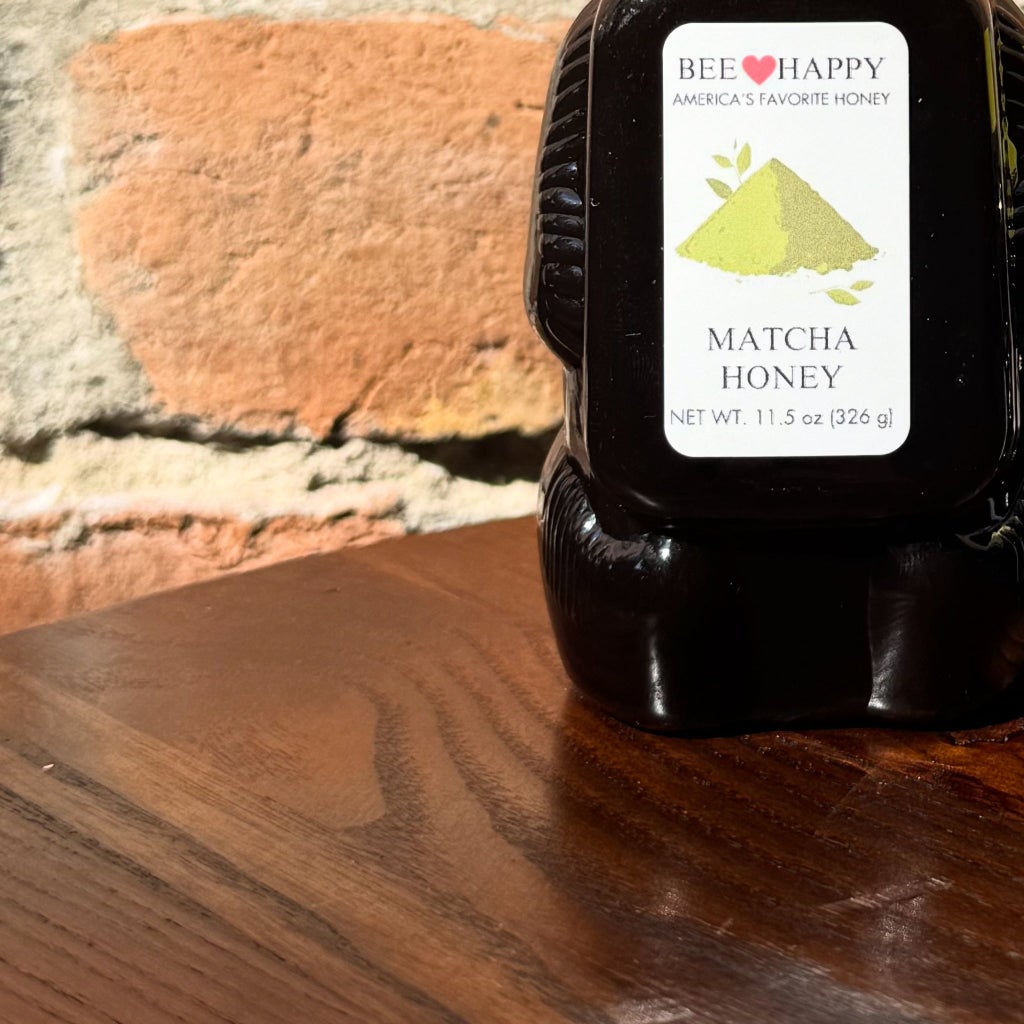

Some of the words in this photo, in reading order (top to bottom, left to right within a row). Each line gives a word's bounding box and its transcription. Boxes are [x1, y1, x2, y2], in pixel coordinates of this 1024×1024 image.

[679, 57, 738, 80] BEE
[778, 57, 886, 80] HAPPY
[672, 92, 754, 106] AMERICA'S
[759, 92, 829, 105] FAVORITE
[834, 91, 891, 105] HONEY
[707, 326, 858, 351] MATCHA
[721, 365, 844, 390] HONEY
[670, 409, 705, 425] NET
[711, 409, 746, 425] WT.
[757, 409, 795, 426] 11.5
[802, 413, 824, 425] oz
[830, 408, 870, 429] (326
[877, 407, 893, 429] g)
